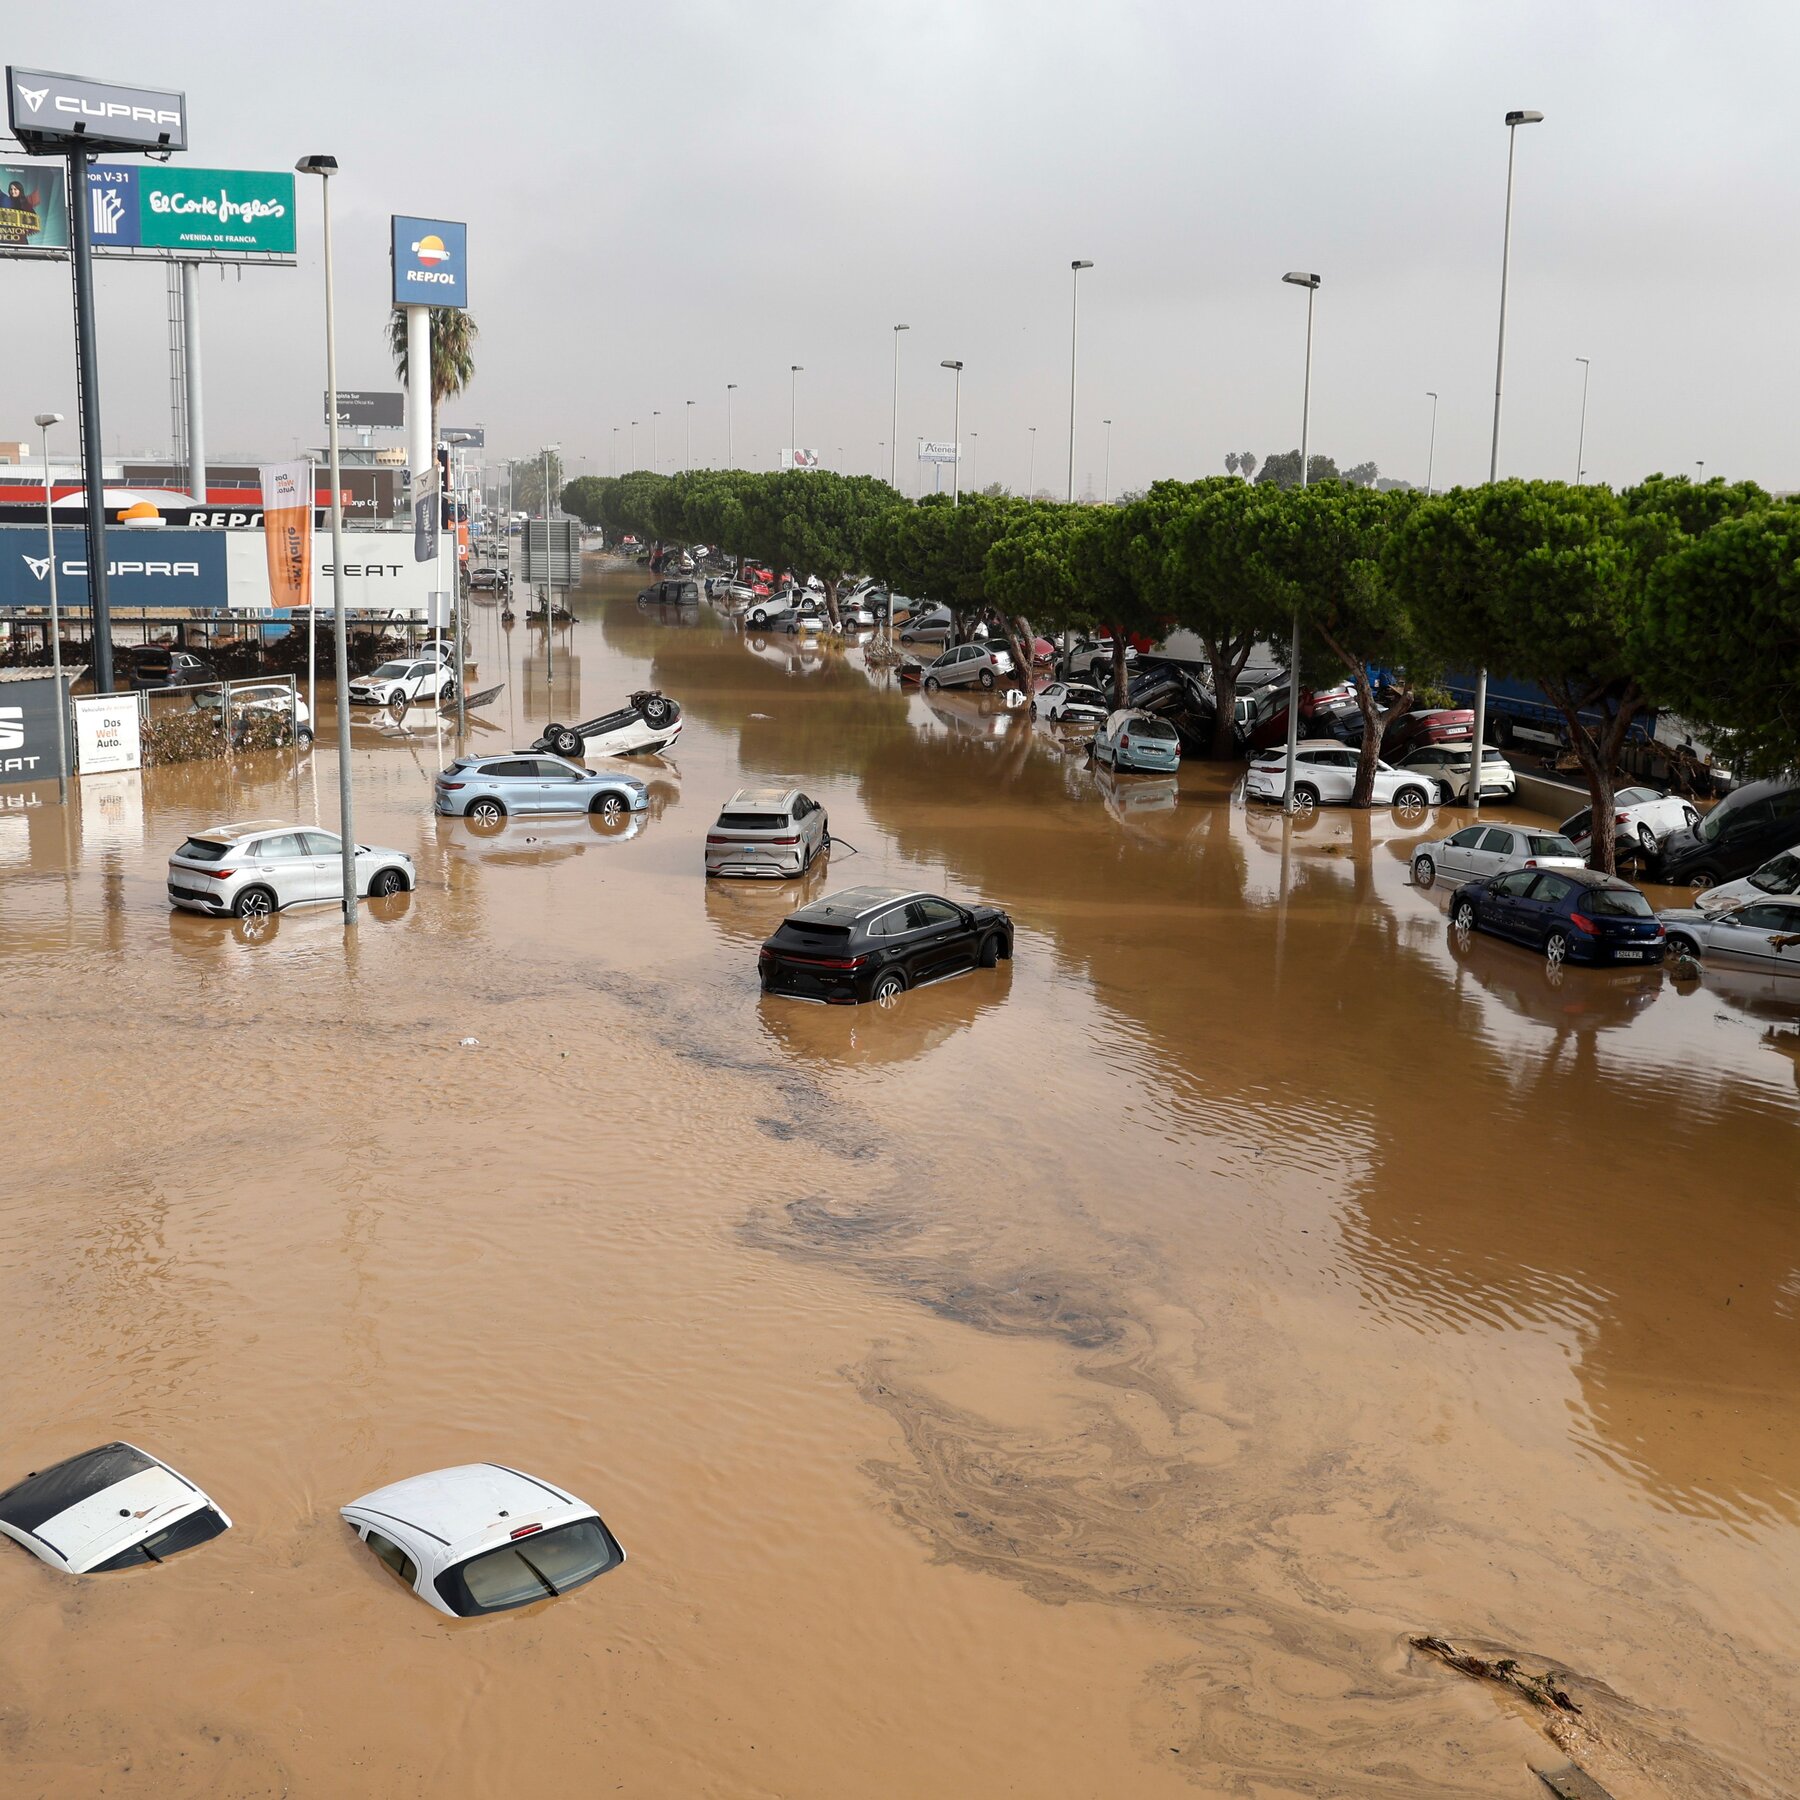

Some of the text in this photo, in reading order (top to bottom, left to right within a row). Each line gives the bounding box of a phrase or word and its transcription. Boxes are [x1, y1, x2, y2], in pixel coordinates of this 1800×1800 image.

[55, 96, 181, 127] CUPRA
[104, 172, 129, 183] V-31
[149, 189, 285, 223] El Corte Inglés
[180, 233, 256, 243] AVENIDA DE FRANCIA
[407, 270, 455, 285] REPSOL
[188, 512, 264, 527] REPS
[321, 565, 404, 577] SEAT
[103, 719, 121, 728] Das
[96, 728, 118, 739] Welt
[97, 738, 122, 749] Auto.
[0, 756, 40, 772] AT
